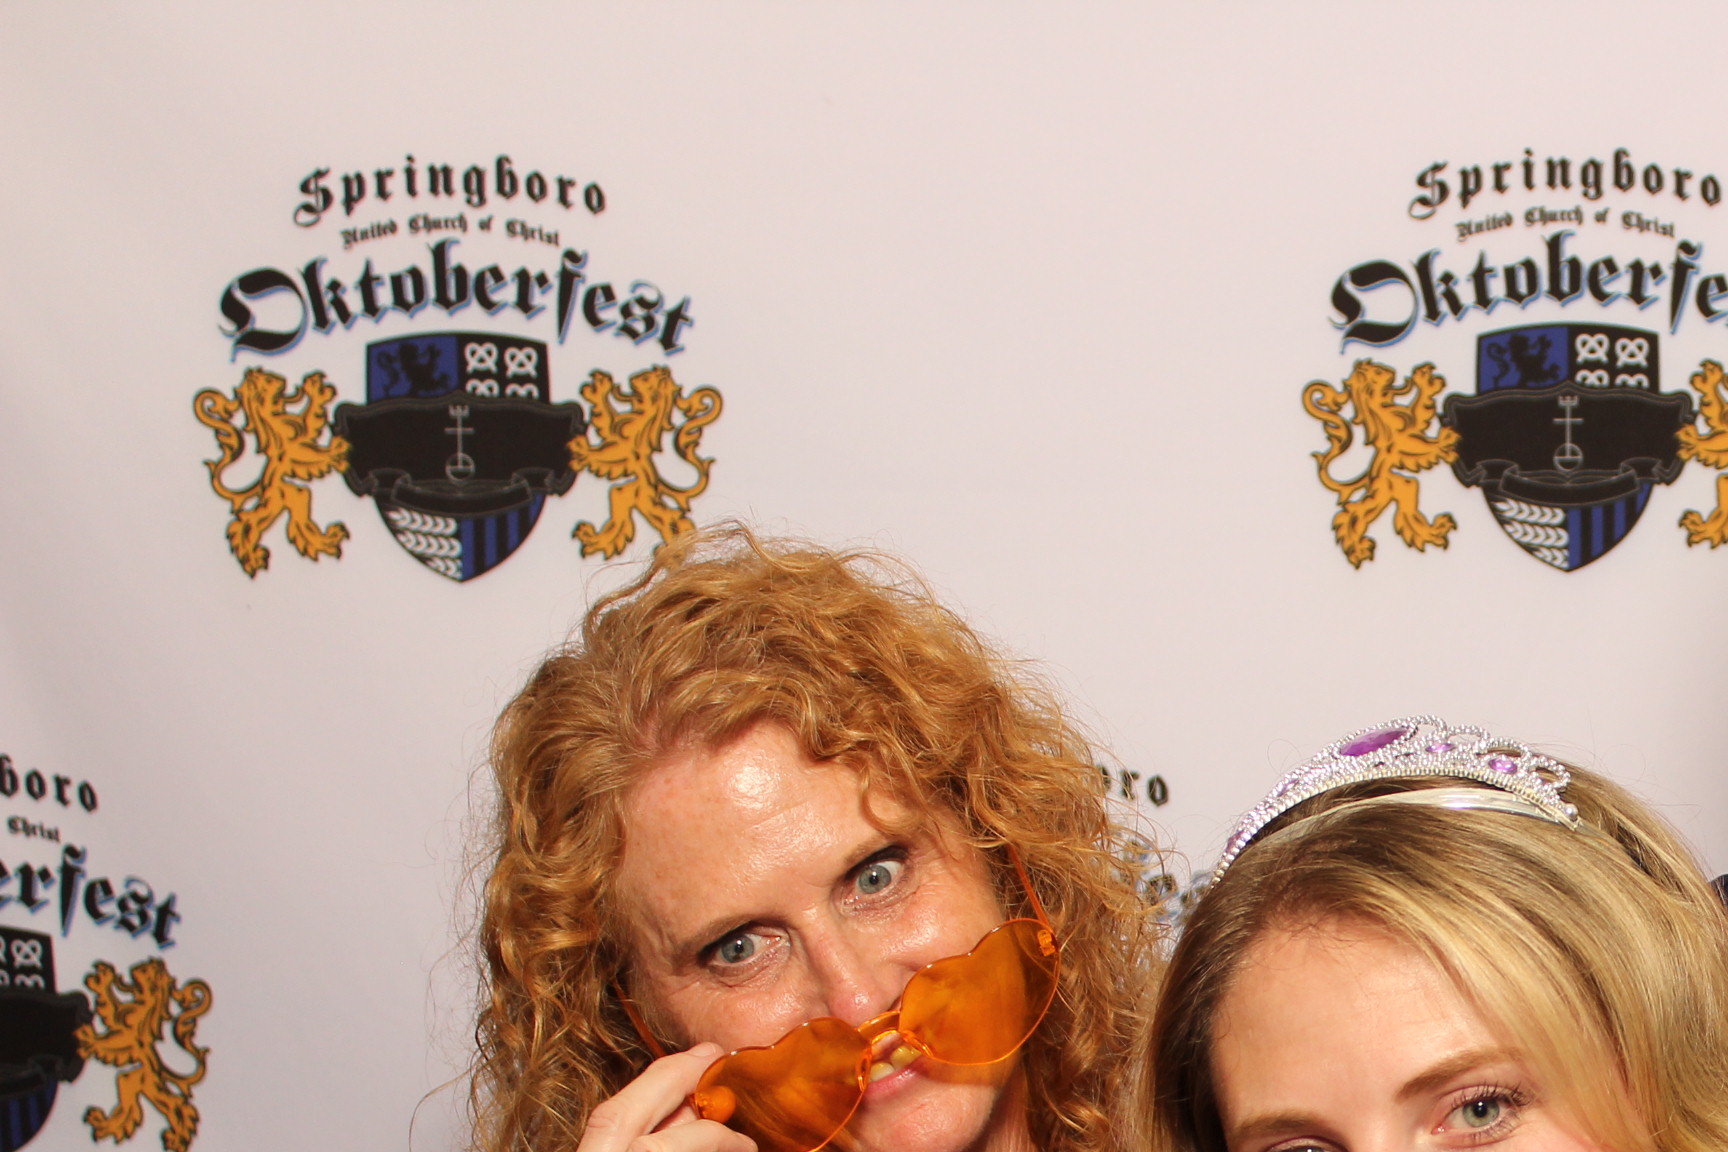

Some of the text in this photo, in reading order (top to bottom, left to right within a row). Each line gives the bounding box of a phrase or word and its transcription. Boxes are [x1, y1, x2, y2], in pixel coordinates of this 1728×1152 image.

[294, 154, 606, 227] Springboro
[1408, 147, 1721, 220] Springboro
[341, 213, 560, 249] United Church of Christ
[1455, 206, 1675, 243] United Church of Christ
[217, 237, 693, 363] Oktoberfest
